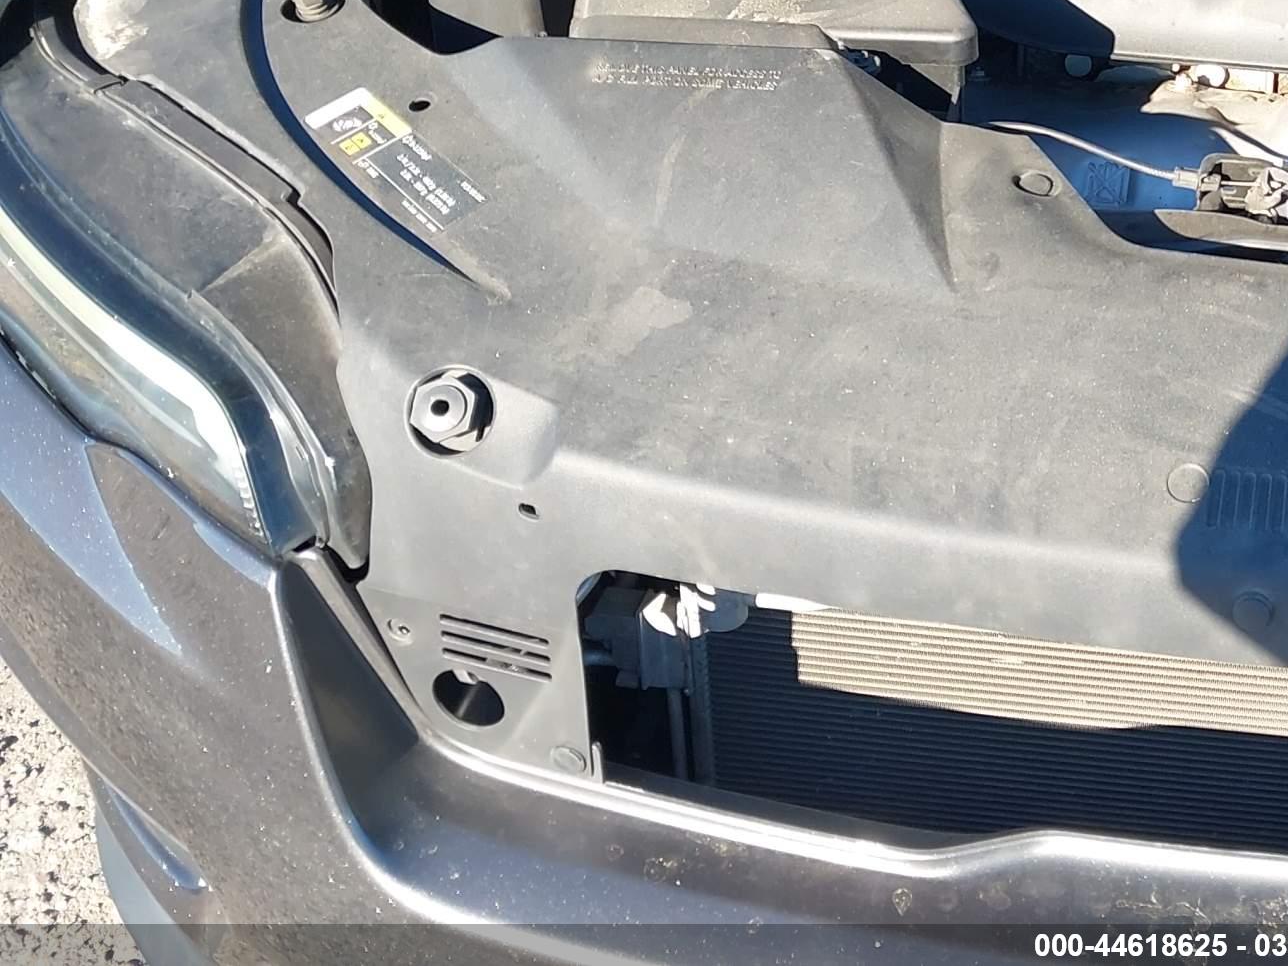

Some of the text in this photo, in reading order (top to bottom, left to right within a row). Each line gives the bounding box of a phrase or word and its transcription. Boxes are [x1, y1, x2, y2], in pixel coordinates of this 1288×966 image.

[641, 64, 665, 75] THIS
[667, 65, 699, 76] PANEL
[703, 66, 723, 77] FOR
[727, 80, 778, 91] VEHICLES
